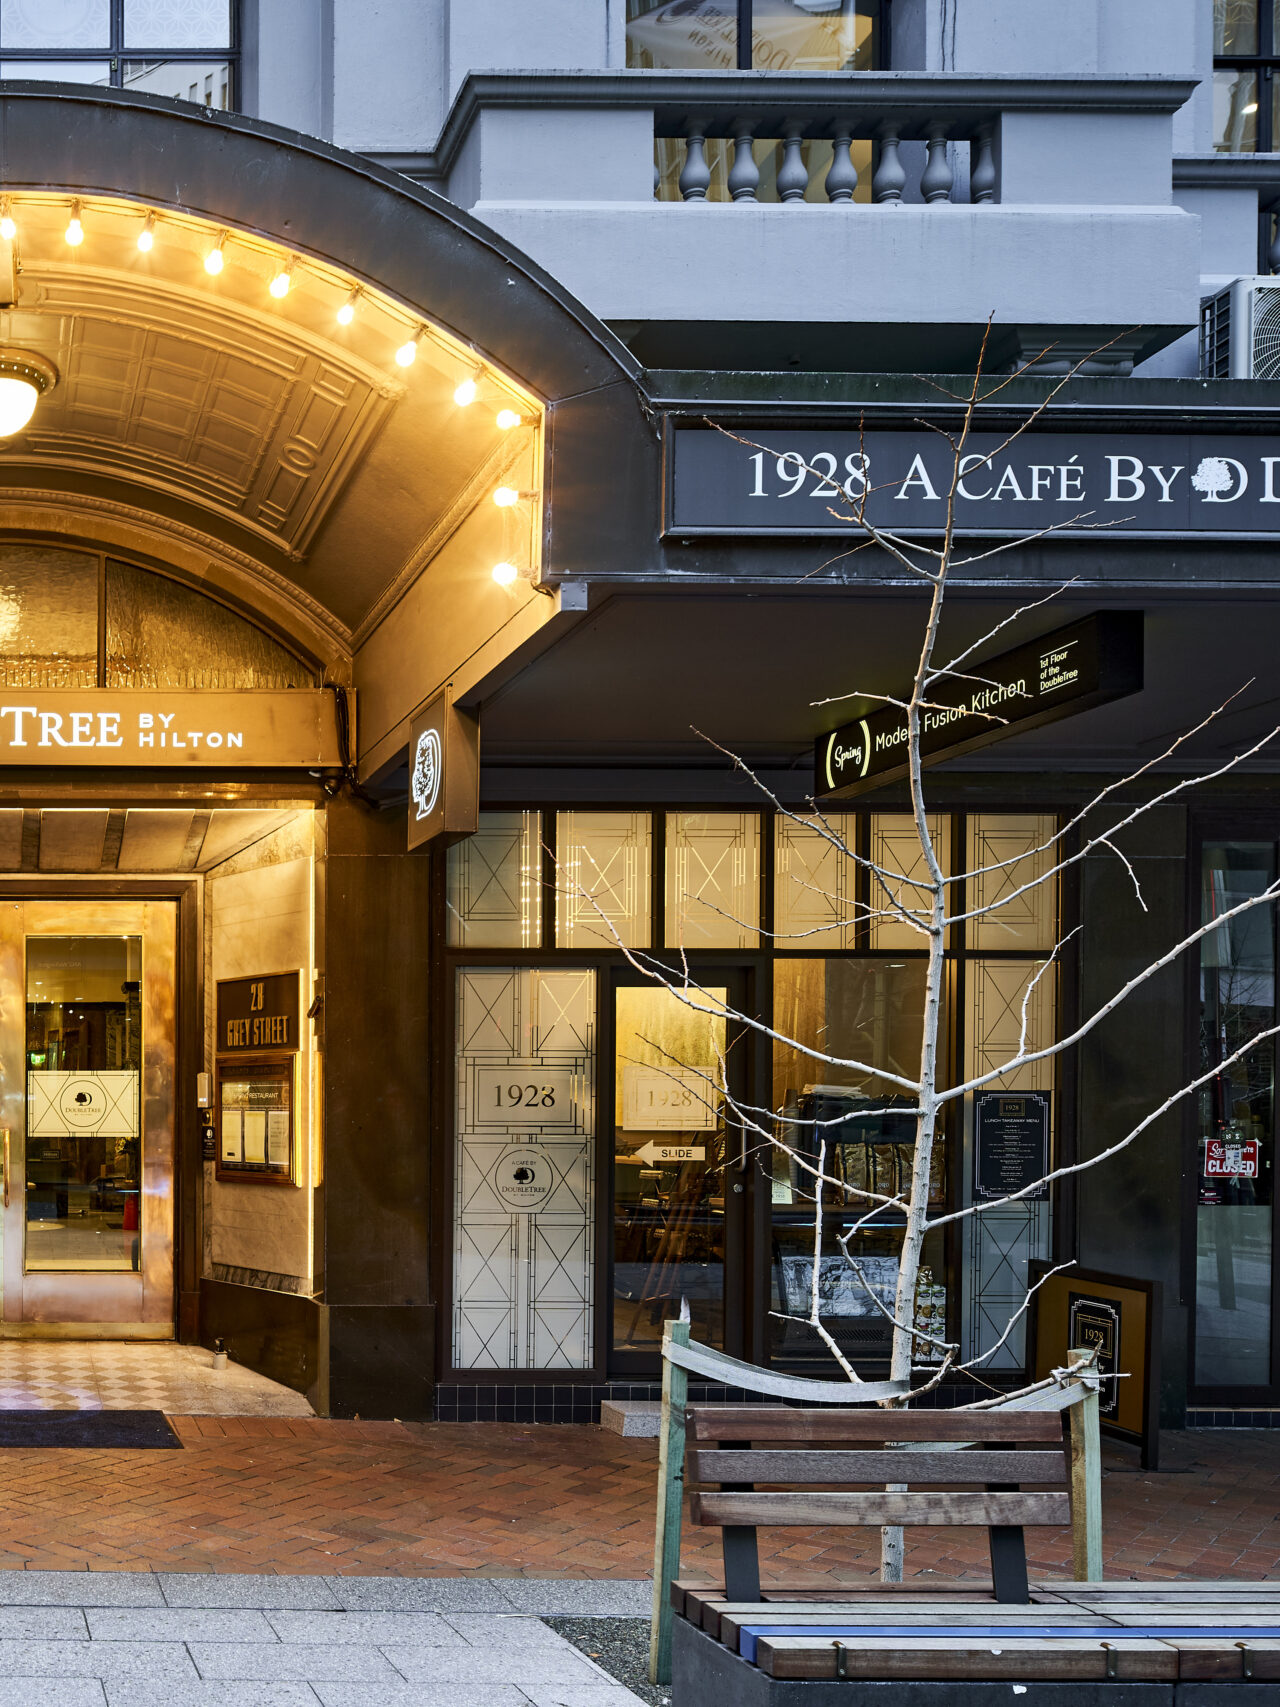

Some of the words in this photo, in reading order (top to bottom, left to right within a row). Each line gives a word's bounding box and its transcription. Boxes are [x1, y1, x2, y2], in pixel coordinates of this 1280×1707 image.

[748, 452, 872, 499] 1928
[894, 453, 941, 500] A
[1104, 455, 1185, 502] BY
[1040, 657, 1048, 669] 1st
[1050, 651, 1068, 665] Floor
[1040, 669, 1047, 680] of
[1048, 666, 1060, 676] the
[1040, 670, 1078, 691] DoubleTree
[138, 713, 176, 728] BY
[875, 726, 911, 752] Mode
[924, 703, 967, 733] Fusion
[971, 679, 1026, 713] Kitchen
[138, 732, 244, 748] HILTON
[250, 982, 265, 1011] 28
[227, 1018, 252, 1047] GREY
[253, 1015, 288, 1046] STREET
[494, 1084, 556, 1108] 1928
[649, 1090, 693, 1107] 1928
[661, 1149, 693, 1158] SLIDE
[1207, 1160, 1255, 1173] CLOSED
[1084, 1328, 1104, 1342] 1928
